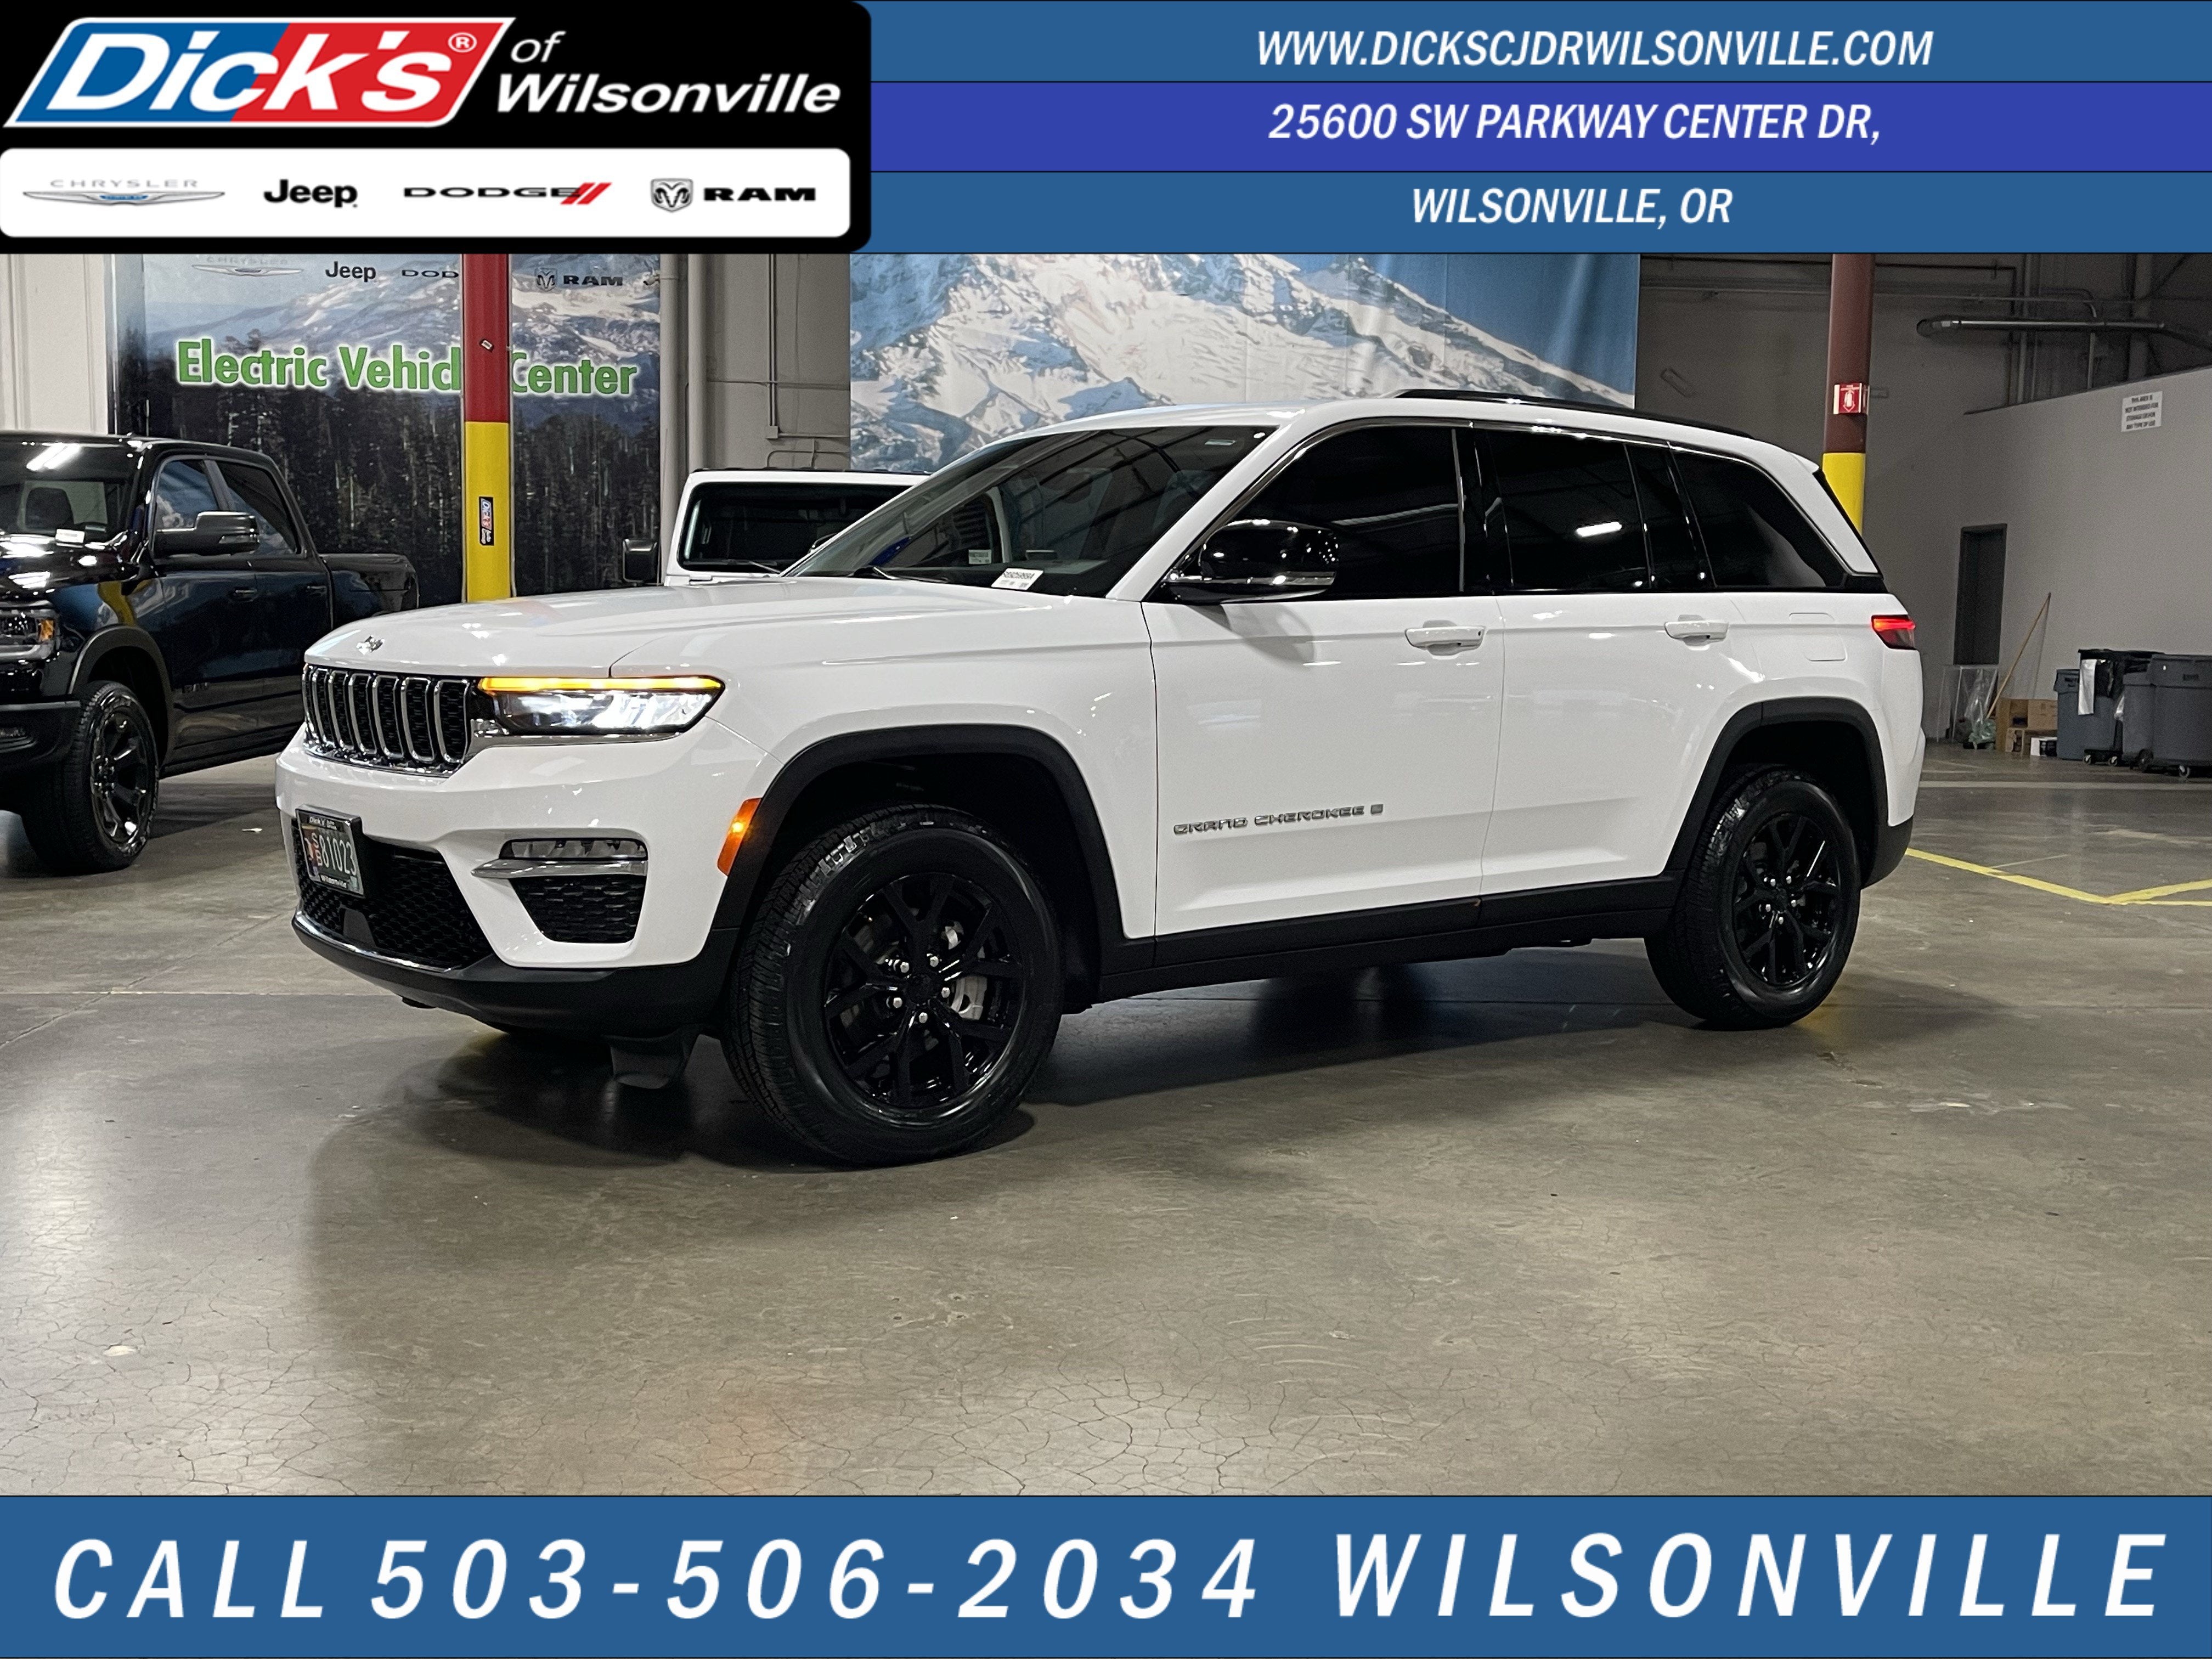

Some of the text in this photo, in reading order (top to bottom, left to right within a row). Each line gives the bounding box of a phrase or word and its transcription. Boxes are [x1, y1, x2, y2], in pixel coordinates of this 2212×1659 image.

[325, 261, 377, 283] Jeep
[401, 269, 459, 278] DOD
[563, 275, 623, 286] RAM
[178, 338, 637, 394] Electric Vehicl Center
[1173, 805, 1365, 836] GRAND CHEROKEE
[319, 834, 357, 876] 81023
